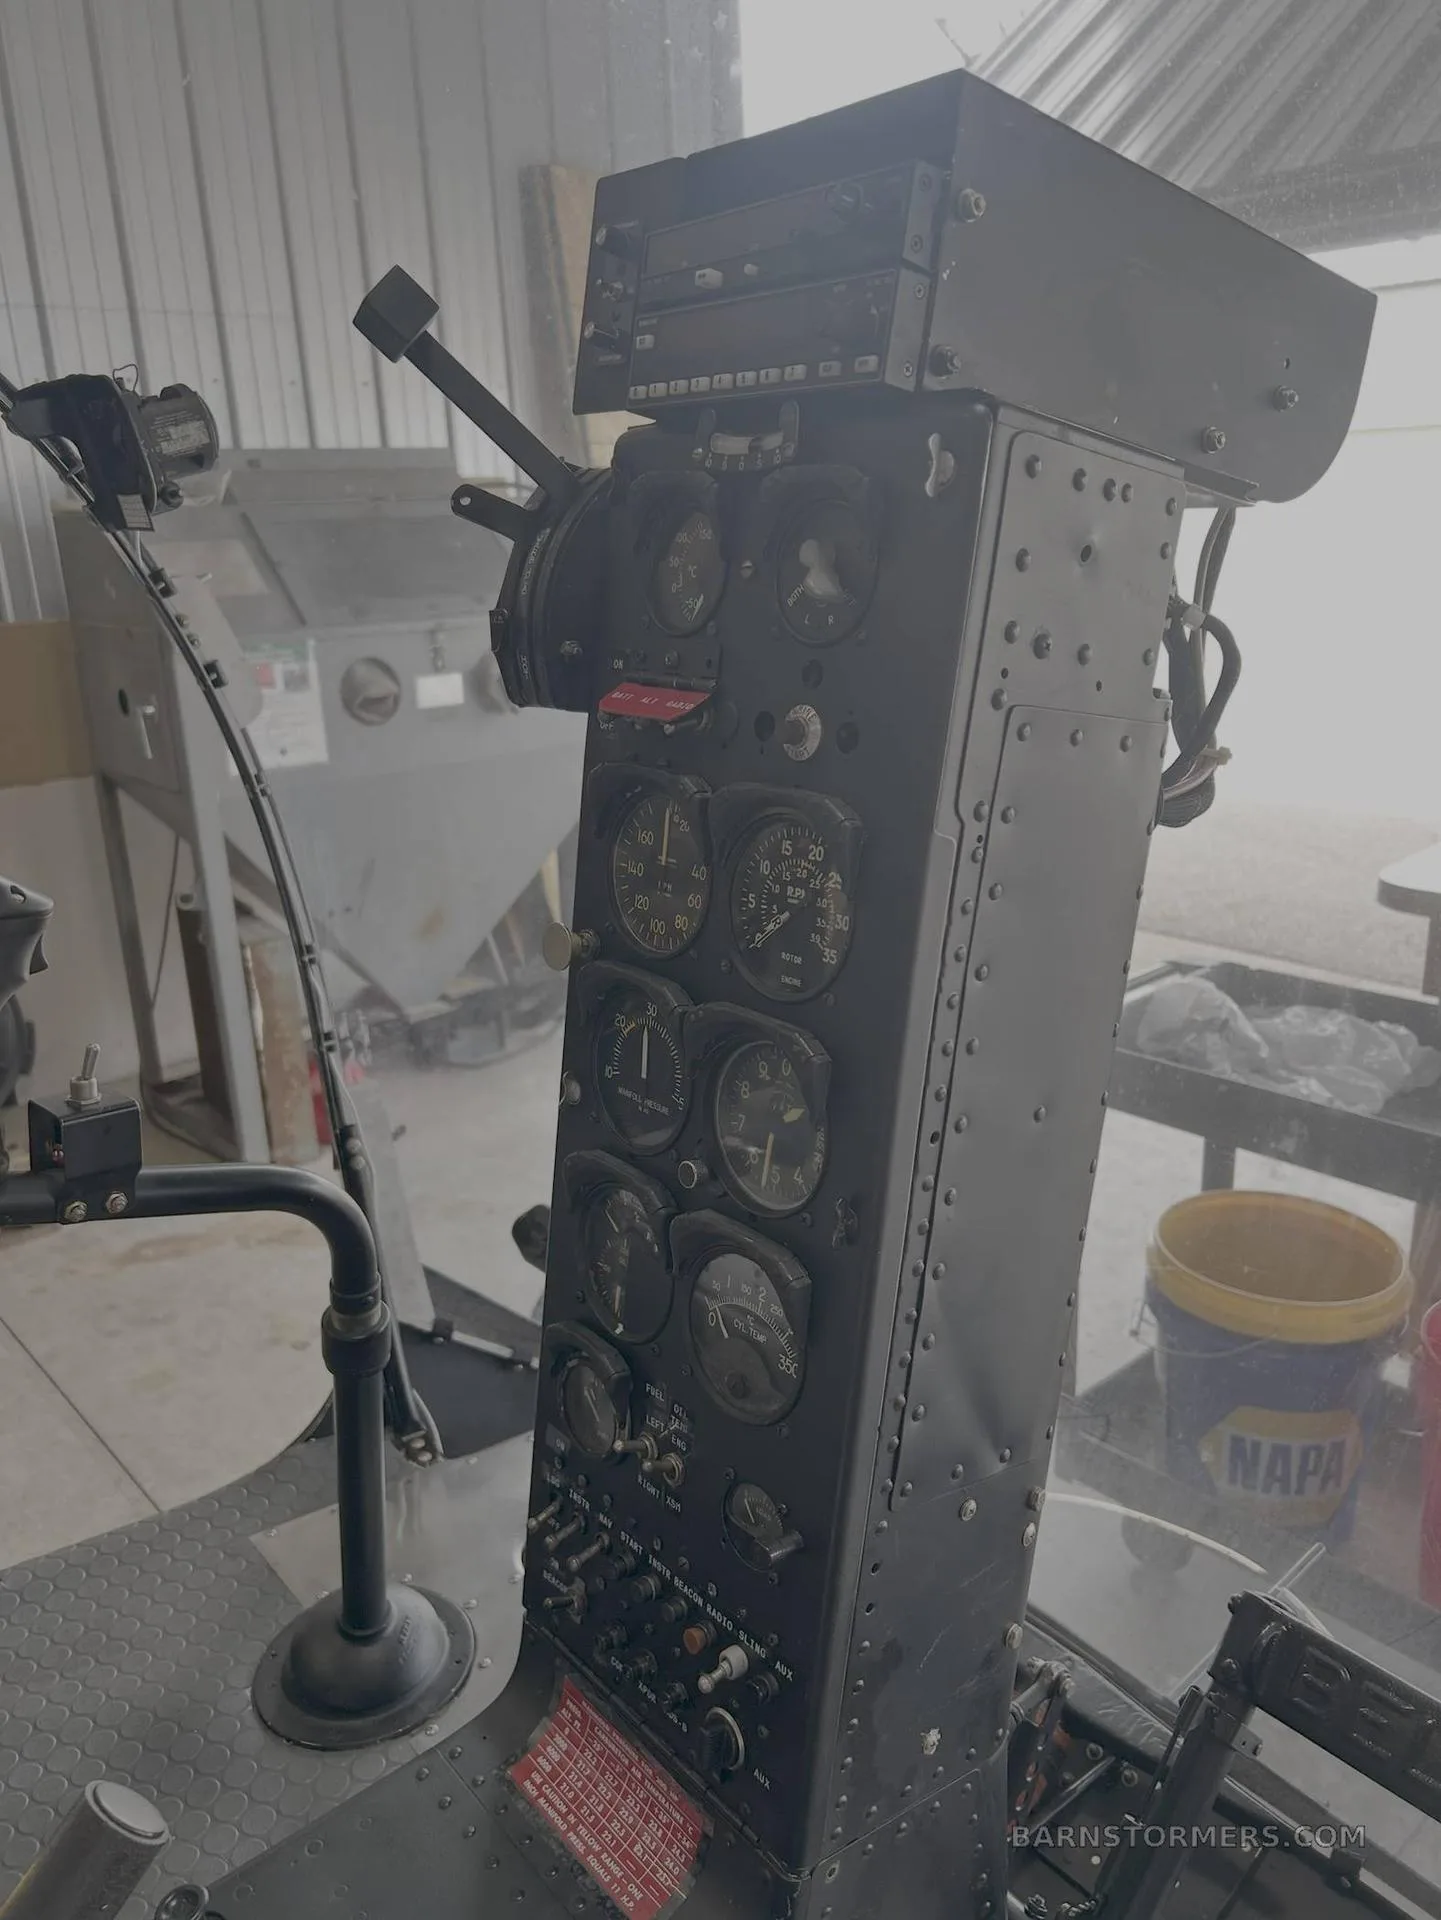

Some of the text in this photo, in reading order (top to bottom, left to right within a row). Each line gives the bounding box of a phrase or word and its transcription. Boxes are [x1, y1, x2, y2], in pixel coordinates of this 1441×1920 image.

[738, 461, 745, 470] 0
[786, 583, 806, 607] BOTH
[828, 614, 834, 625] R
[612, 659, 624, 670] ON
[612, 691, 634, 701] BATT
[640, 696, 658, 705] ALT
[679, 819, 690, 833] 20
[636, 829, 654, 846] 160
[781, 839, 793, 857] 15
[808, 844, 824, 862] 20
[627, 860, 707, 881] 140 40
[759, 860, 770, 875] 10
[634, 894, 649, 911] 120
[687, 894, 702, 909] 60
[748, 893, 756, 909] 5
[649, 913, 689, 936] 100 80
[834, 914, 850, 932] 30
[781, 951, 803, 965] ROTOR
[822, 948, 838, 965] 35
[780, 975, 802, 987] ENGINE
[646, 1001, 658, 1017] 30
[615, 1013, 627, 1027] 20
[604, 1065, 613, 1079] 10
[741, 1080, 750, 1099] 8
[738, 1114, 746, 1131] 7
[772, 1165, 781, 1184] 5
[793, 1166, 802, 1185] 4
[758, 1286, 767, 1303] 2
[708, 1312, 716, 1327] 0
[747, 1314, 755, 1327] °C
[645, 1382, 665, 1403] FUEL
[645, 1414, 665, 1433] LEFT
[671, 1434, 687, 1452] ENG
[1227, 1436, 1348, 1497] NAPA
[637, 1473, 660, 1500] RIGHT
[568, 1488, 591, 1513] INSTR
[598, 1511, 613, 1530] NAV
[543, 1569, 569, 1595] BEACON
[619, 1530, 794, 1683] START INSTR BEACON RADIO SLING AUX
[752, 1767, 772, 1791] AUX
[643, 1778, 685, 1823] TEMPERATURE
[560, 1783, 574, 1798] 21.0
[580, 1806, 594, 1821] 21.5
[601, 1831, 616, 1846] 22.1
[575, 1760, 589, 1774] 21.7
[618, 1808, 633, 1823] 22.9
[663, 1858, 679, 1874] 24.0
[530, 1771, 642, 1899] USE CAUTION IN YELLOW RANGE ONE
[610, 1819, 625, 1836] 22.5
[522, 1779, 635, 1910] INCH MANIFOLD PRESS. EQUALS 11 H.P.
[670, 1845, 685, 1861] 24.5
